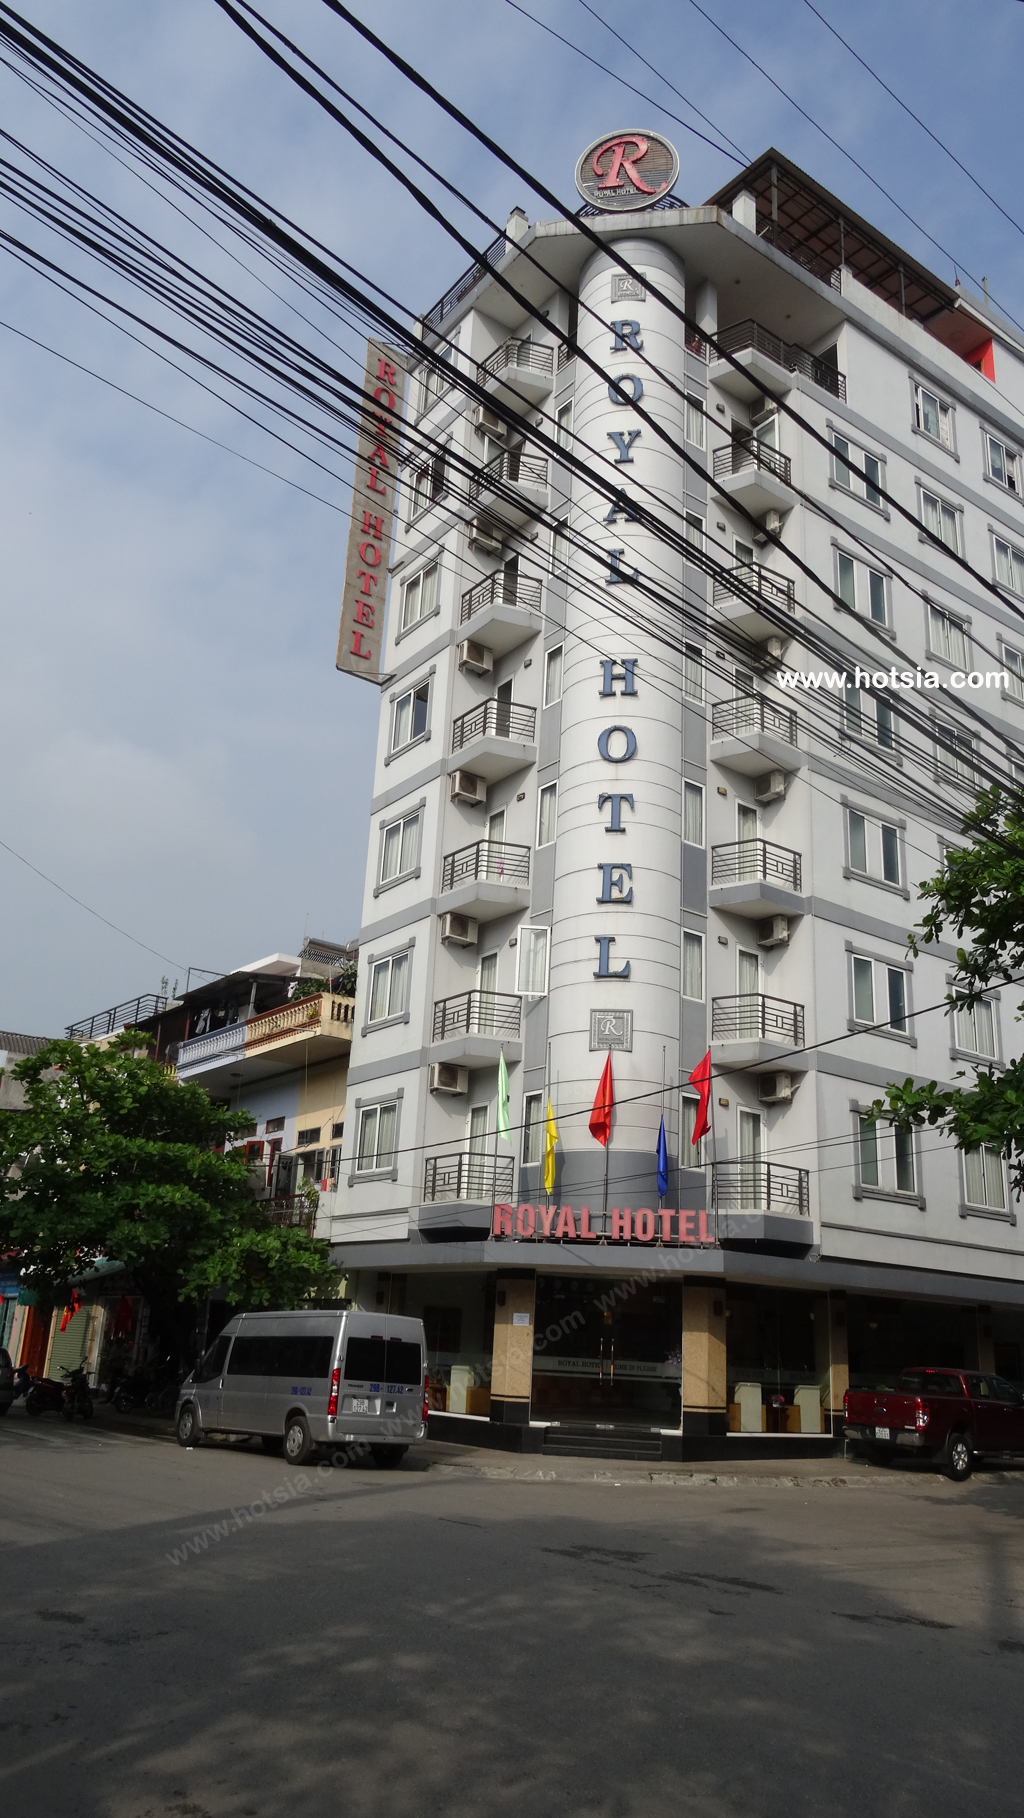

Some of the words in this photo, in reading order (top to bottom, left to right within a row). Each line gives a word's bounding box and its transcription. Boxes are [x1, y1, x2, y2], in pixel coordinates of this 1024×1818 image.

[592, 135, 669, 194] R
[366, 358, 397, 495] ROYAL
[605, 319, 644, 585] ROYAL
[350, 510, 384, 660] HOTEL
[593, 658, 639, 979] HOTEL
[600, 1018, 623, 1036] R
[493, 1204, 597, 1239] ROYAL
[611, 1207, 716, 1243] HOTEL
[558, 1360, 581, 1368] ROYAL
[582, 1361, 602, 1369] HOTE
[636, 1364, 658, 1373] PLEASE
